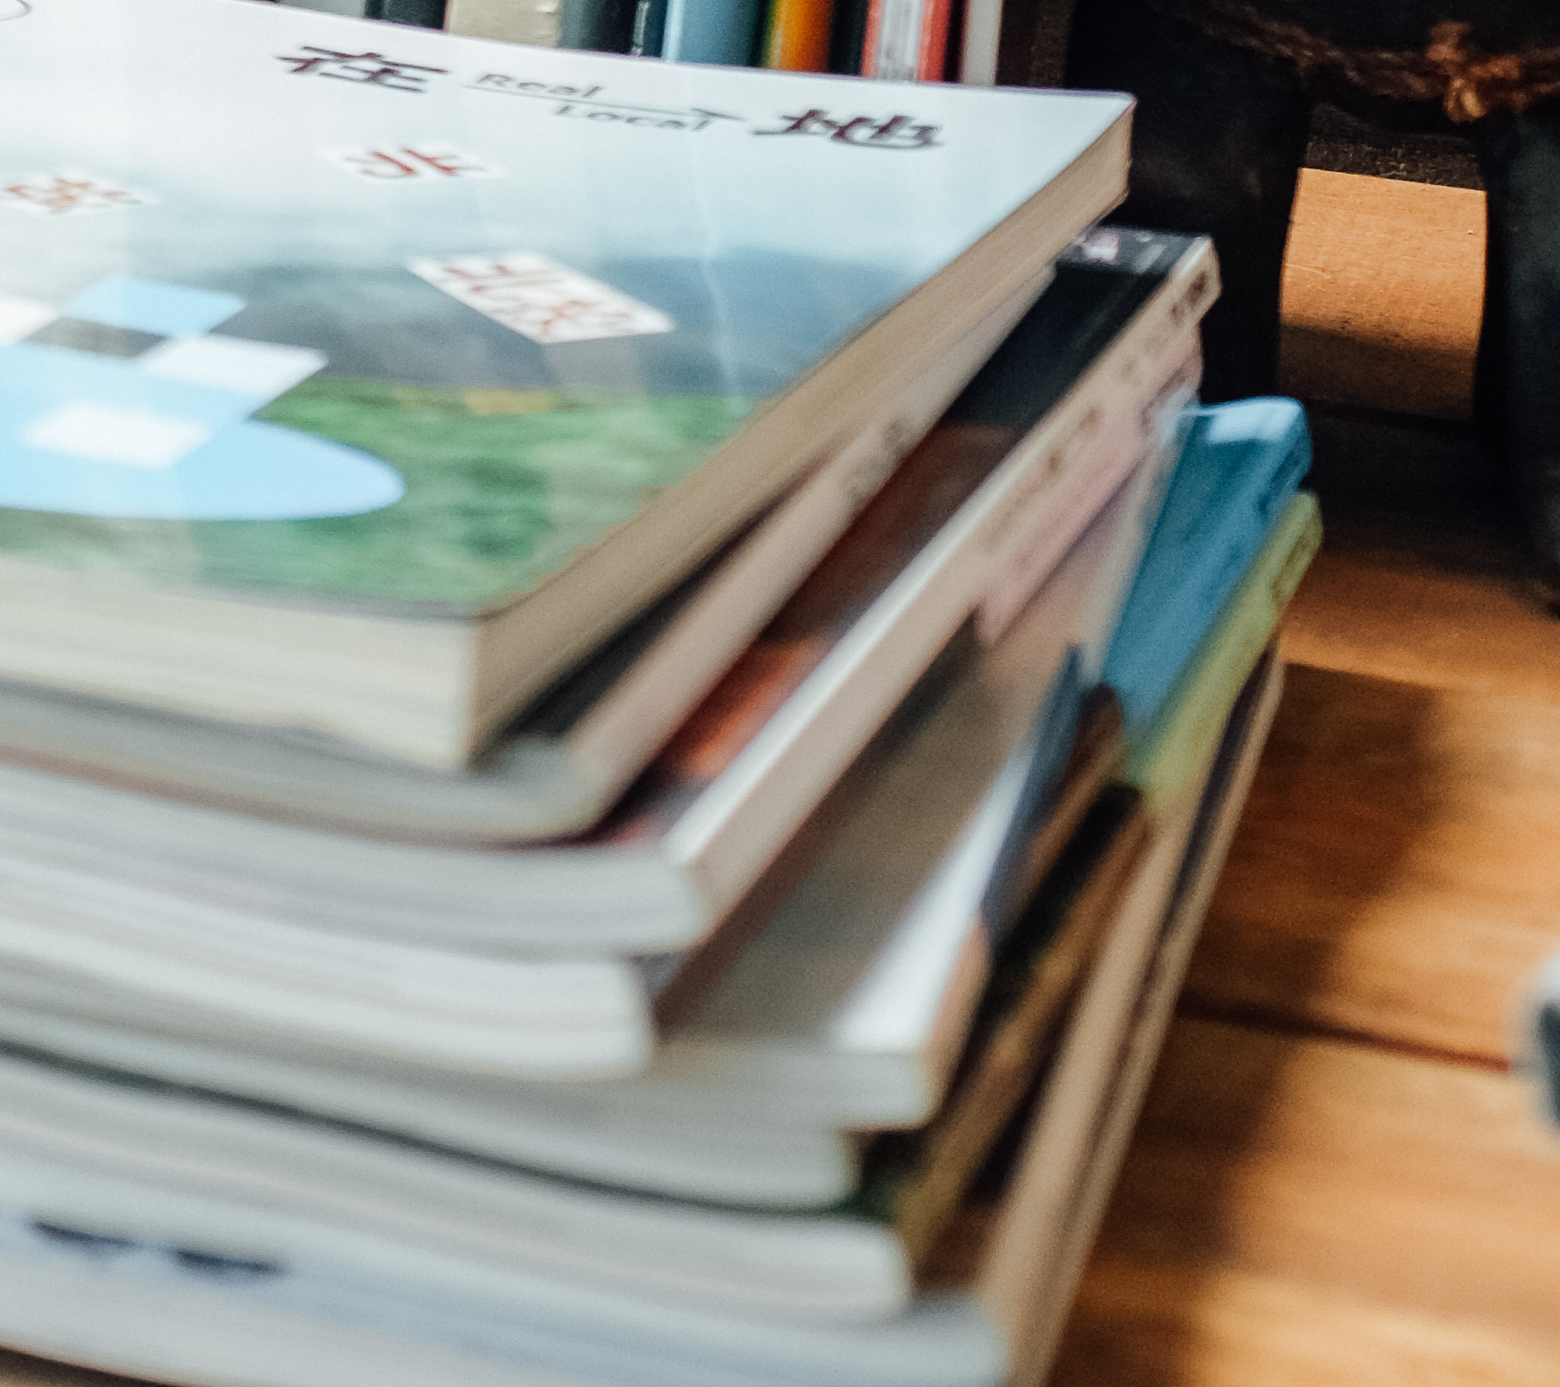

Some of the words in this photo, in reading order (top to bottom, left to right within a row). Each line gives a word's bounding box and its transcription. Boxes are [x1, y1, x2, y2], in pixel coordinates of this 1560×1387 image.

[277, 44, 449, 95] 在
[473, 71, 609, 101] Real
[551, 102, 717, 135] Local
[751, 108, 947, 150] 地
